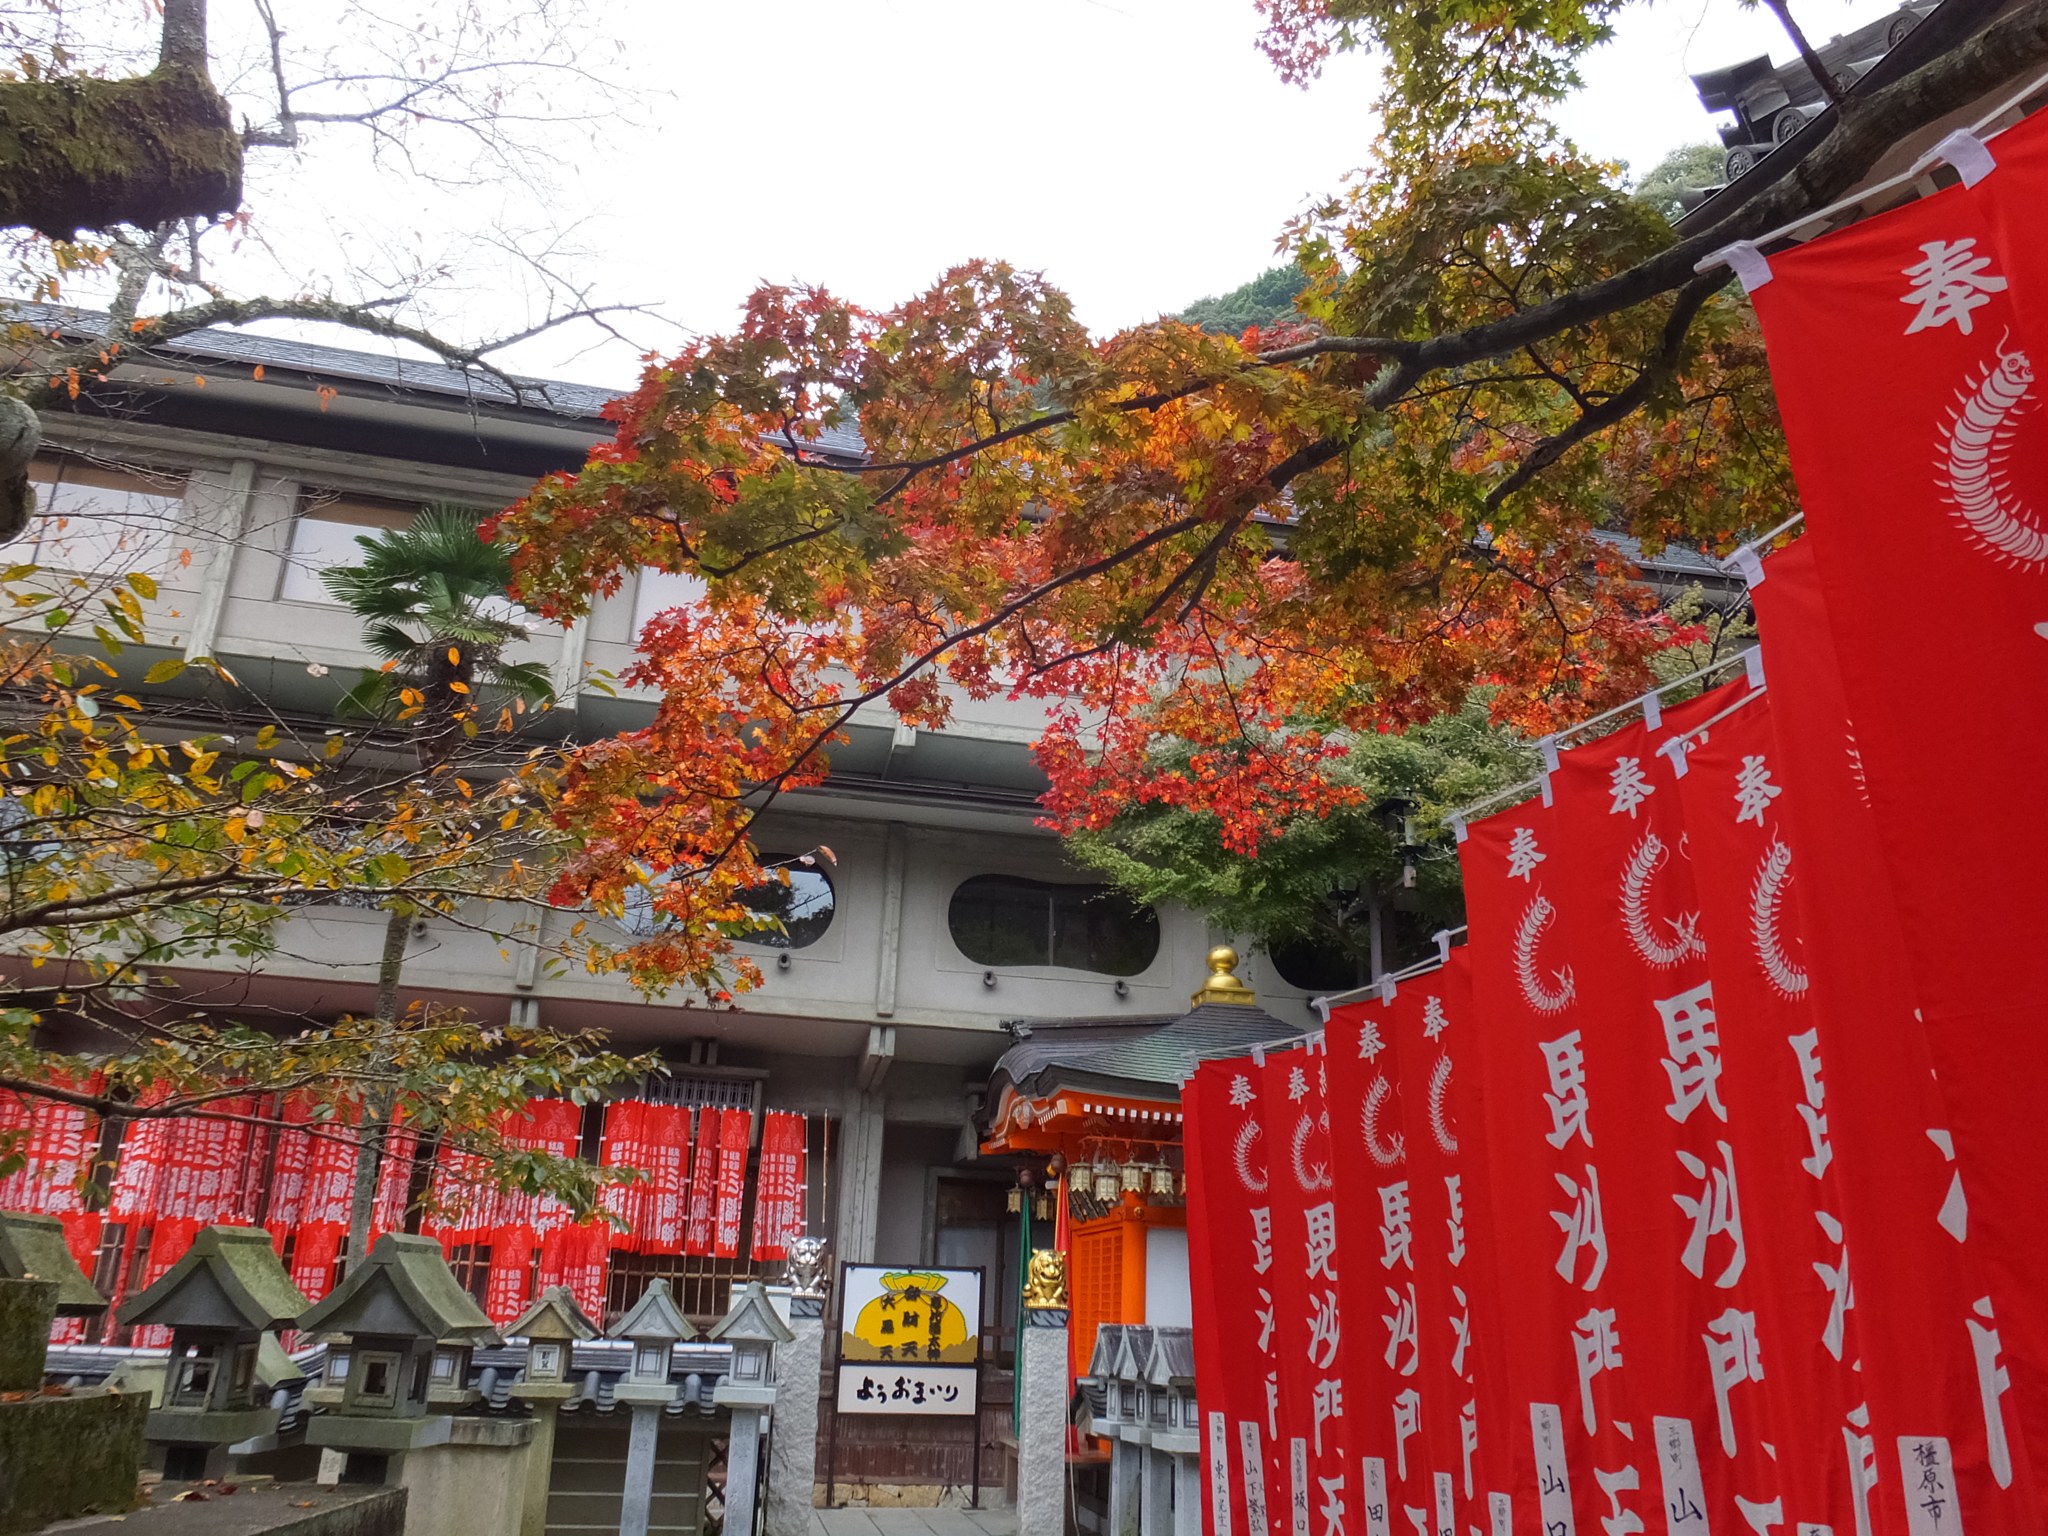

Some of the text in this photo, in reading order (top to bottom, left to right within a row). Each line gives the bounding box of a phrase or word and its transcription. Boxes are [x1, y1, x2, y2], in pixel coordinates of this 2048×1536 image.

[1900, 238, 2007, 335] 奉
[1609, 757, 1656, 819] 奉
[1735, 756, 1782, 827] 奉
[1507, 827, 1547, 883] 奉
[1358, 1020, 1386, 1064] 奉
[1423, 995, 1449, 1043] 奉
[1229, 1074, 1257, 1111] 奉
[1288, 1066, 1310, 1104] 奉
[1912, 1440, 1947, 1531] 橿原市
